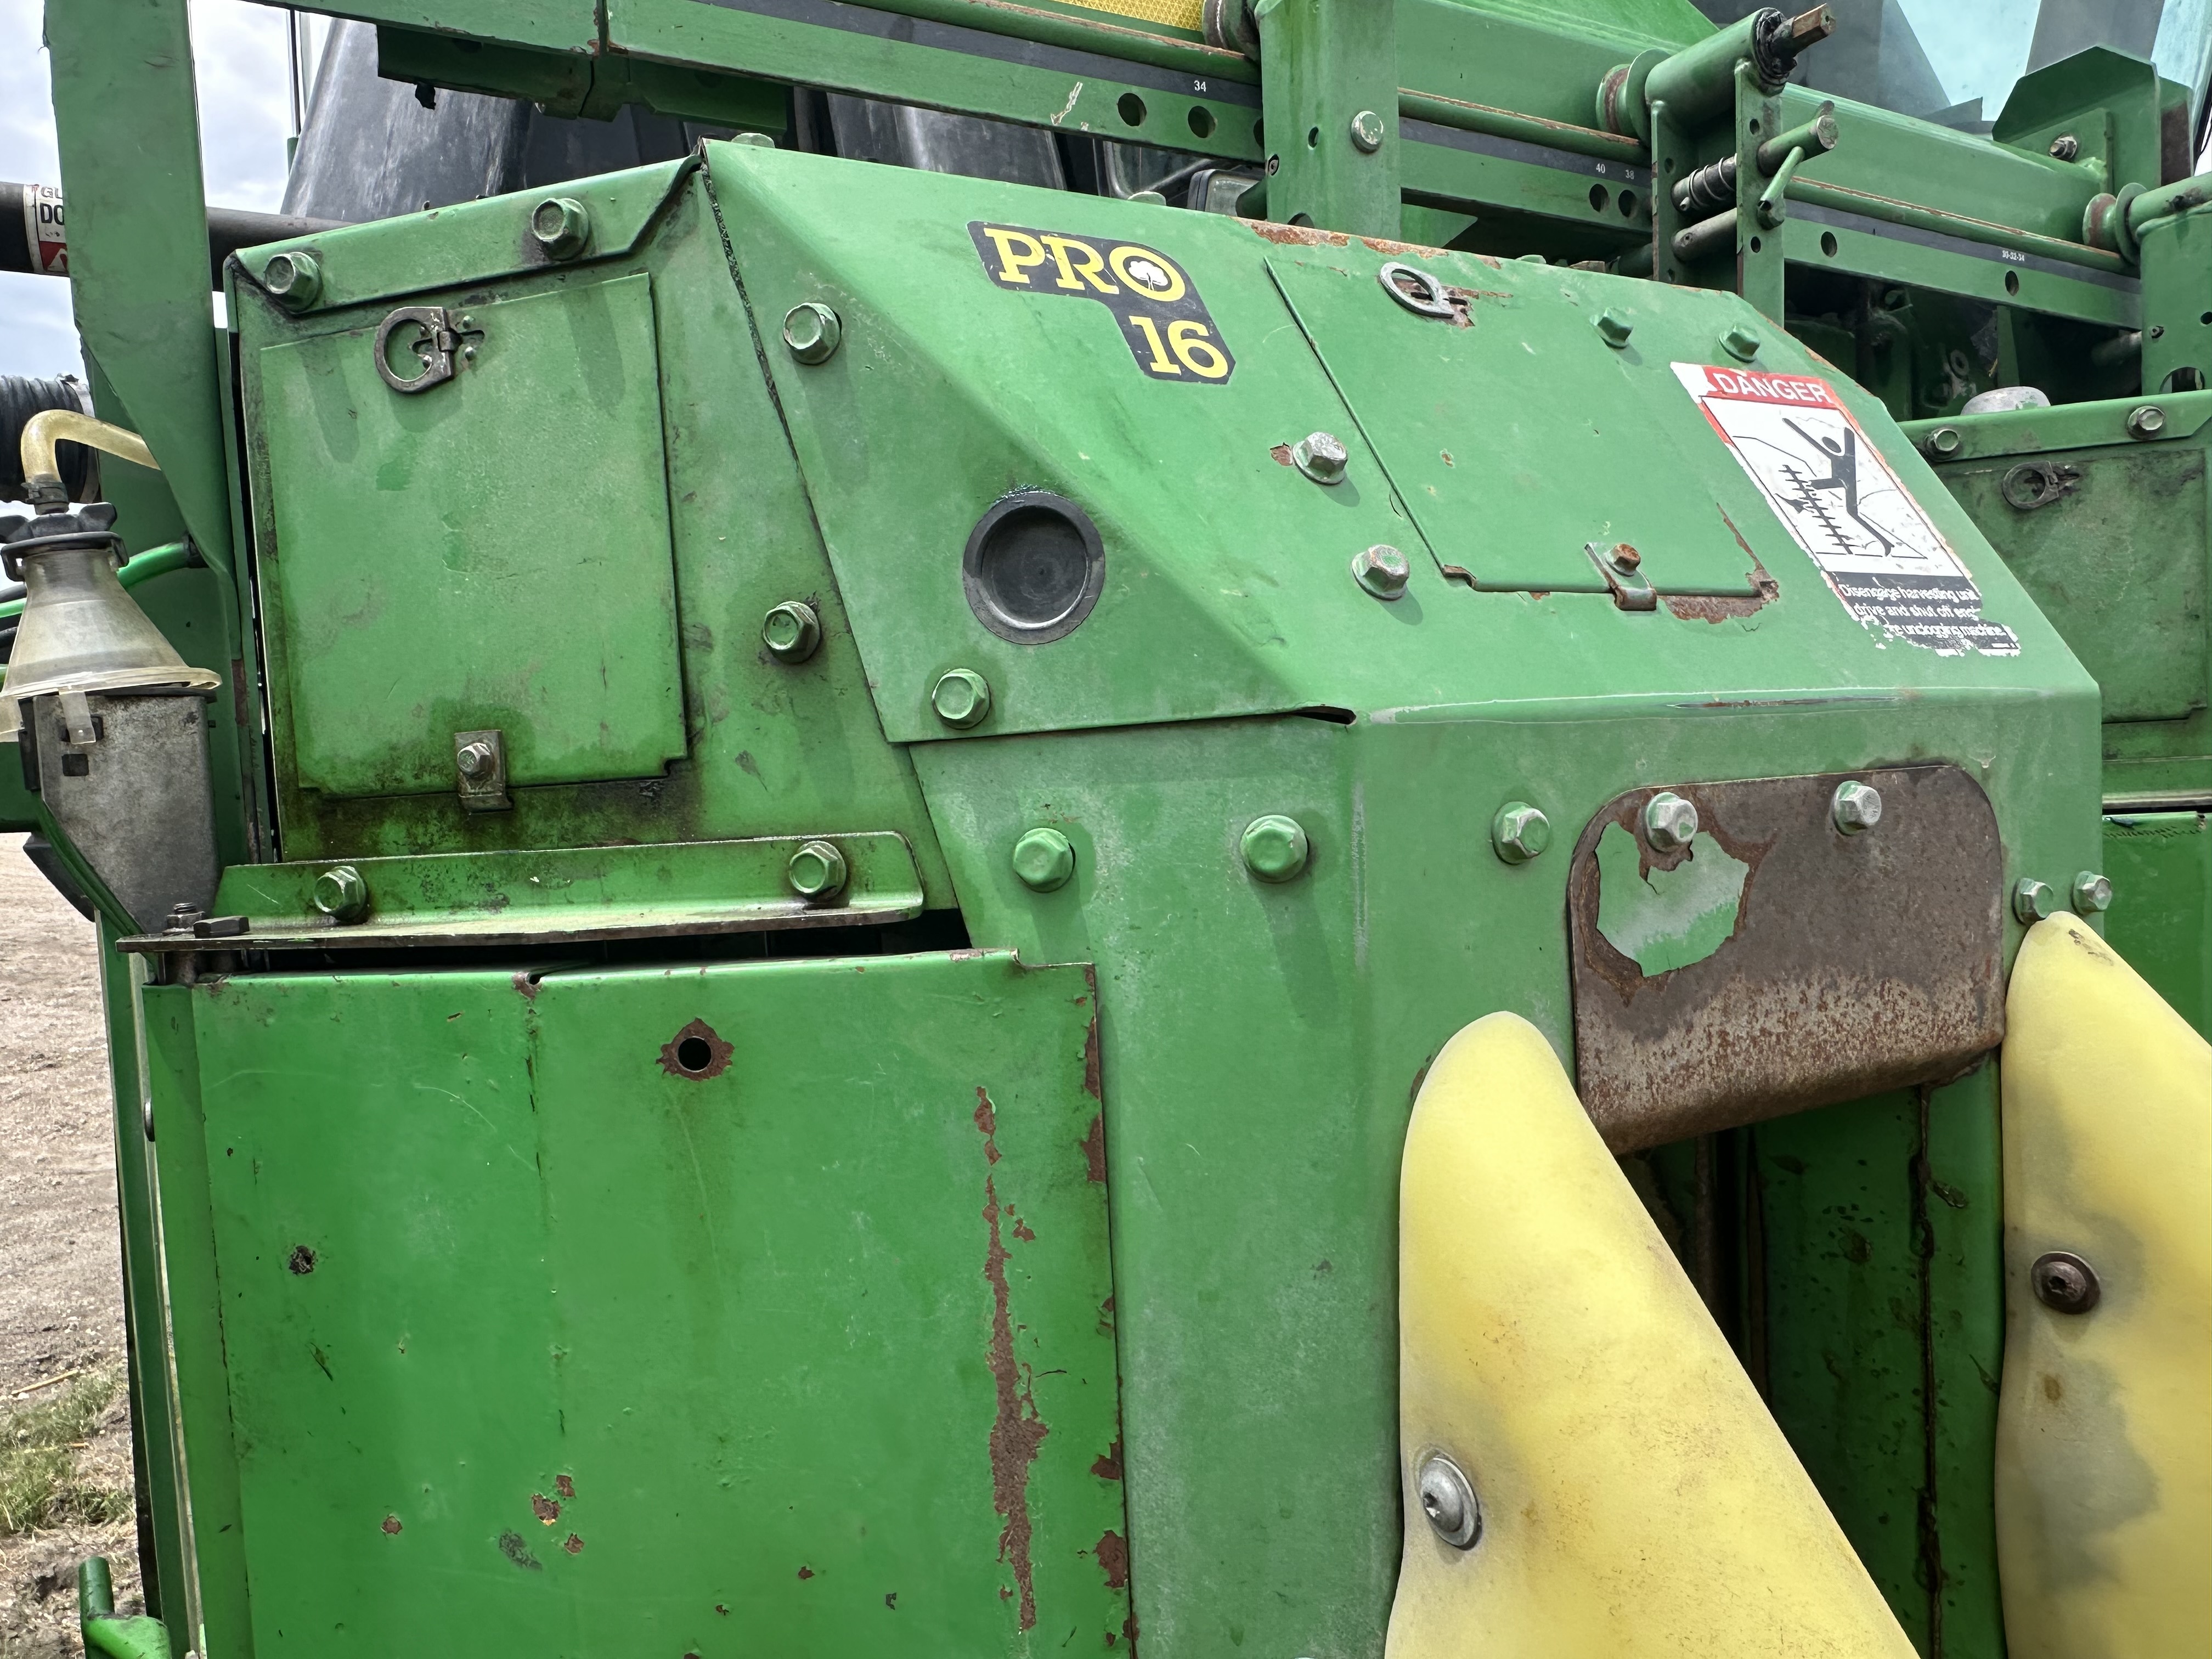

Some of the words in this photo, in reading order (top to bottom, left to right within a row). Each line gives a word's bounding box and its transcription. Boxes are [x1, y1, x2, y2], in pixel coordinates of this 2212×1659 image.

[1194, 80, 1206, 92] 34
[1595, 163, 1605, 174] 40
[984, 227, 1186, 302] PRO
[1128, 315, 1228, 378] 16
[1712, 373, 1835, 404] DANGER
[1838, 584, 1901, 601] Disengage
[1897, 586, 1960, 603] harvesting
[1854, 602, 1886, 616] drive
[1885, 602, 1910, 617] and
[1909, 605, 1939, 617] shut
[1901, 622, 1965, 639] unclogging
